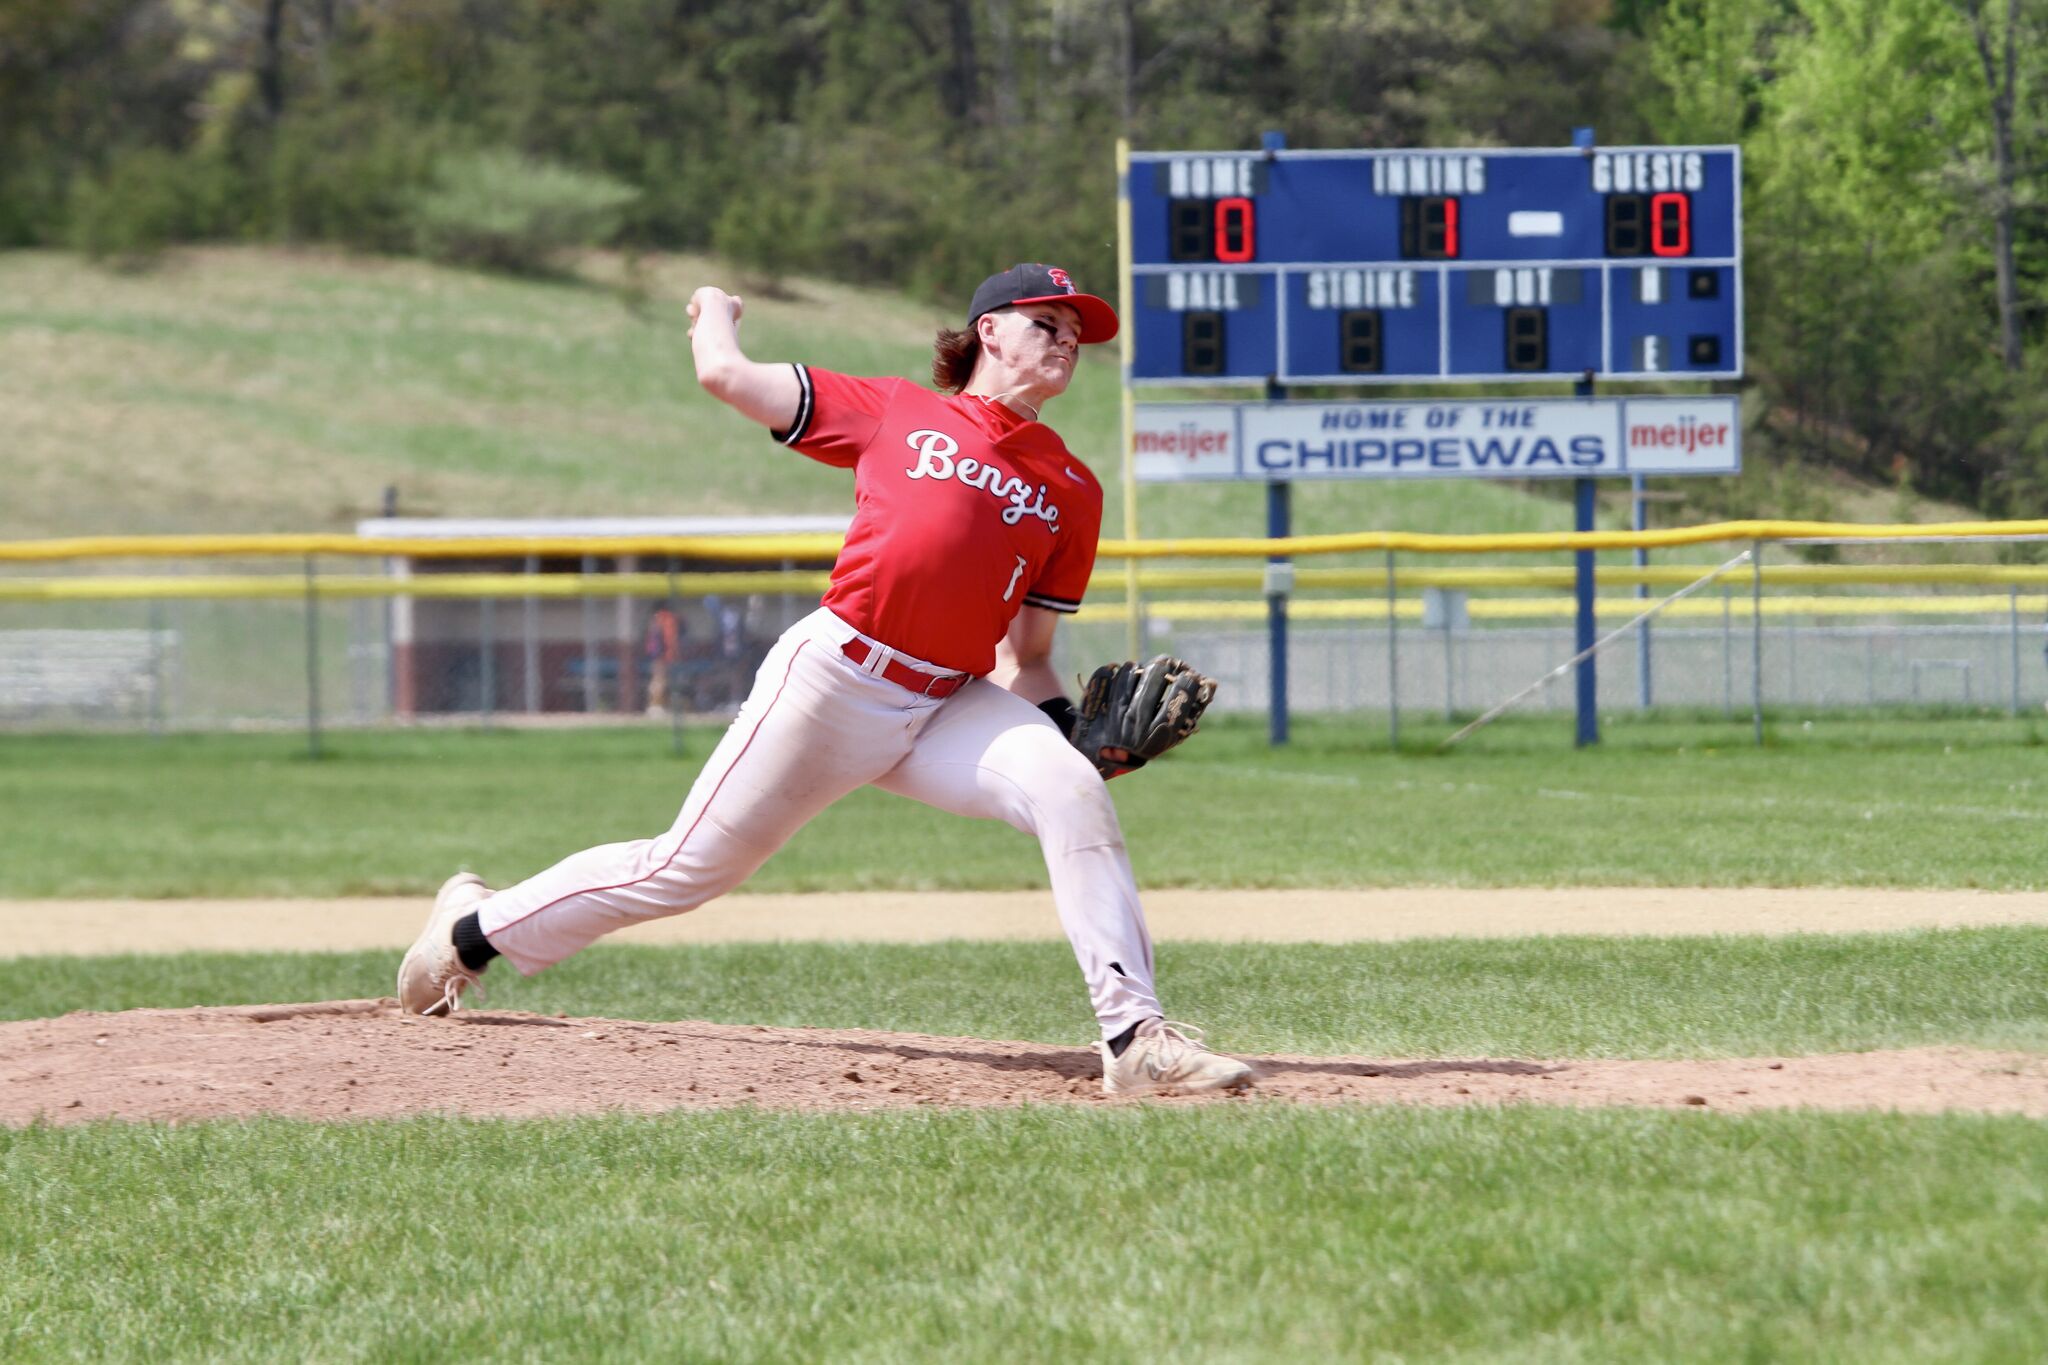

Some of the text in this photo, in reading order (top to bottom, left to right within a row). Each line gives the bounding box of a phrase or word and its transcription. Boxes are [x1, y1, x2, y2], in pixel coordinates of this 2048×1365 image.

[1373, 155, 1486, 195] INNING
[1592, 152, 1703, 193] GUESTS
[1214, 196, 1255, 264] 0
[1444, 197, 1458, 258] 1
[1651, 192, 1690, 257] 0
[1307, 268, 1414, 309] STRIKE
[1494, 267, 1551, 307] OUT
[1321, 405, 1538, 431] HOME OF THE
[1630, 414, 1729, 456] meijer
[1132, 420, 1230, 461] meijer
[1256, 435, 1606, 470] CHIPPEWAS
[905, 429, 1060, 534] Benzie
